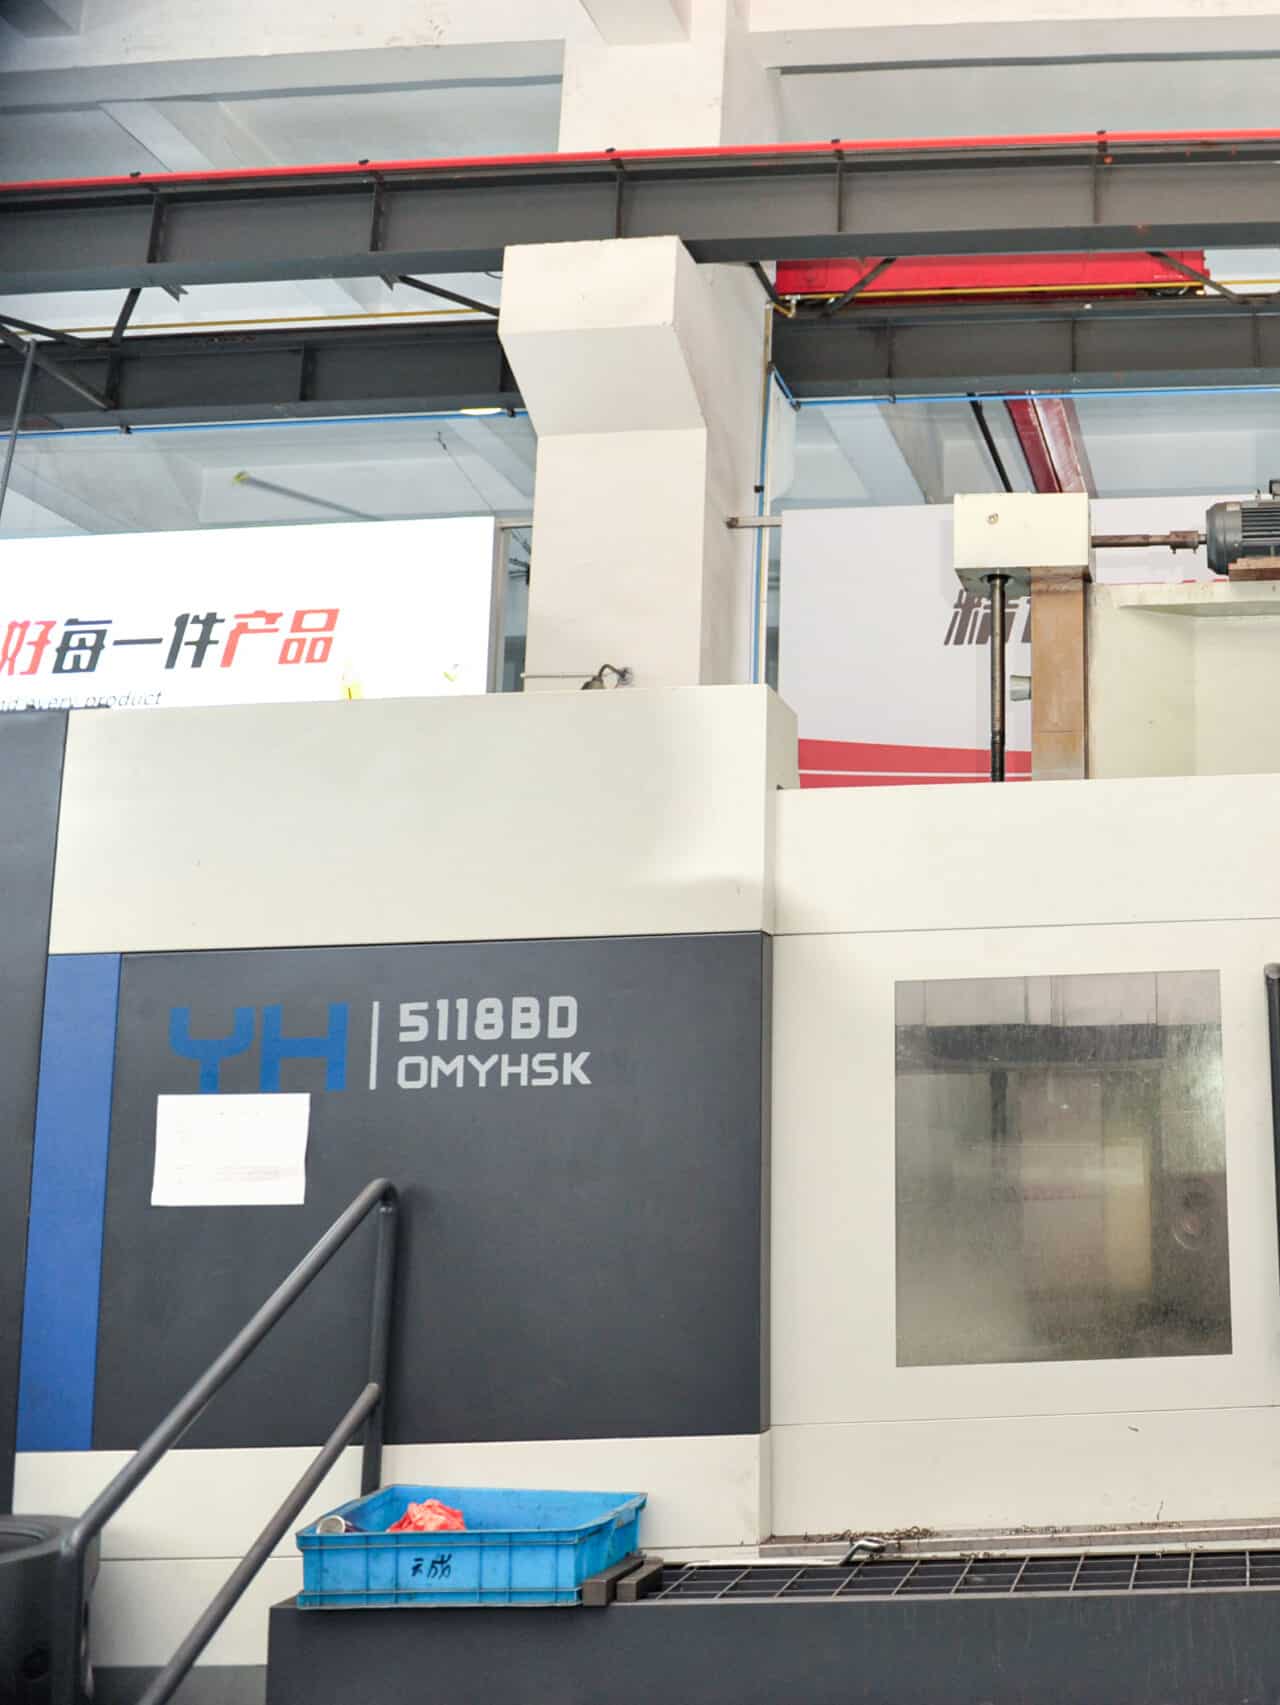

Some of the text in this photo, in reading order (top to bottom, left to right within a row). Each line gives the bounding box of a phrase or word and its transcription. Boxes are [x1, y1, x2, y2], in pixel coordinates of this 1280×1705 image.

[0, 609, 339, 676] 好每一件产品
[168, 1002, 349, 1094] YH
[399, 996, 578, 1043] 5118BD
[397, 1051, 592, 1090] OMYHSK
